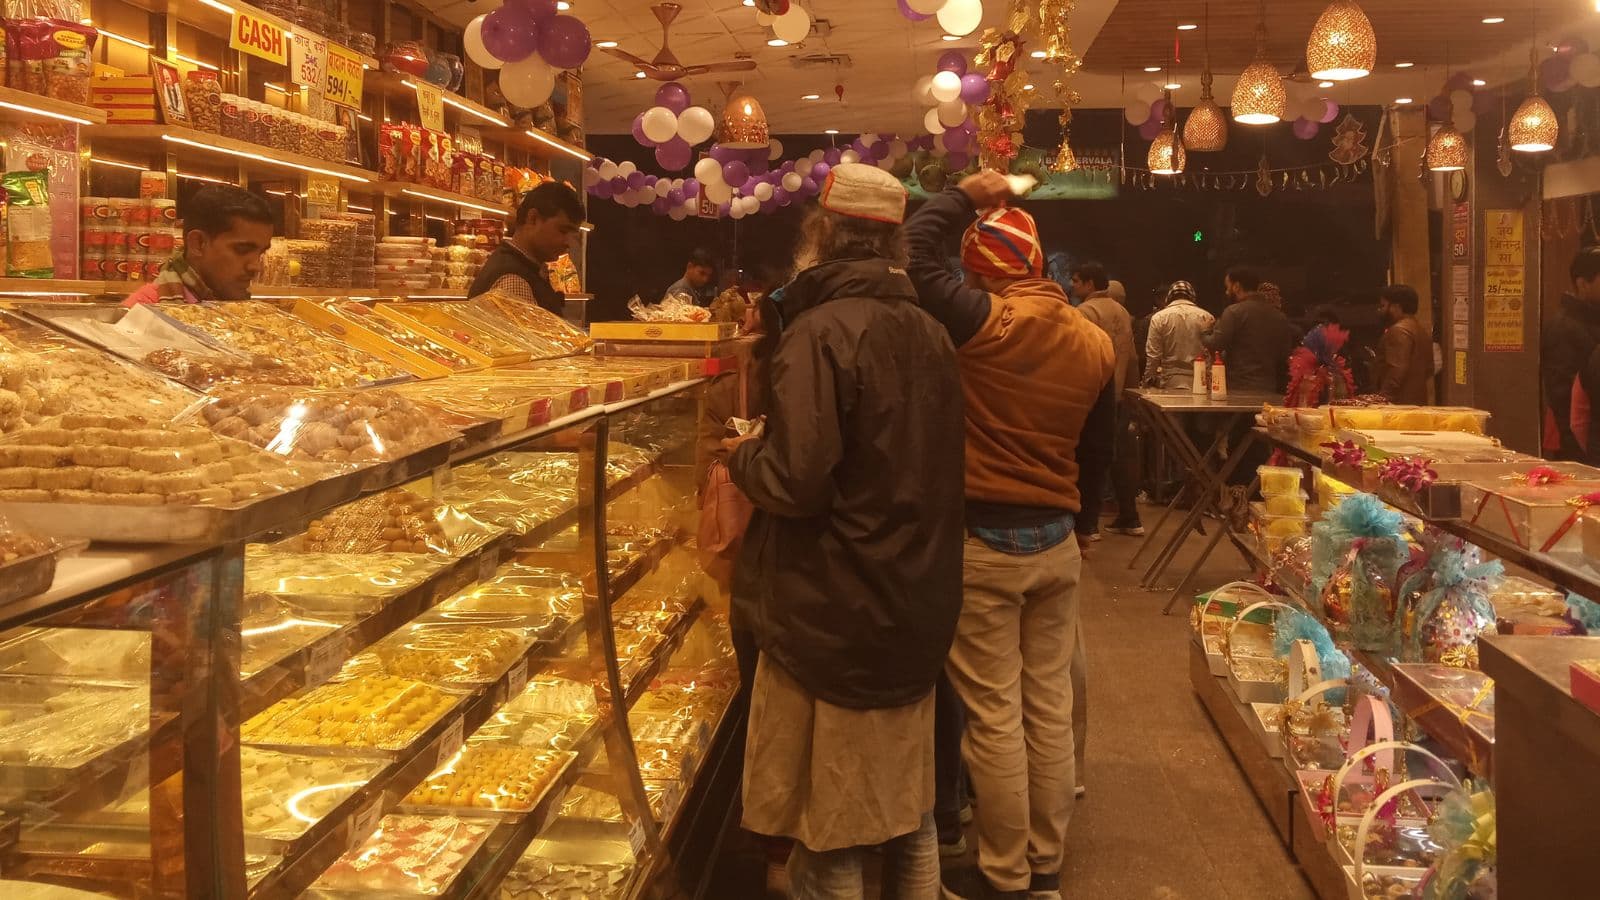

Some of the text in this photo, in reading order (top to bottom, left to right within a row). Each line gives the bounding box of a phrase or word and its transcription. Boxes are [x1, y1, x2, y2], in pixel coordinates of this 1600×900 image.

[238, 14, 283, 57] CASH
[327, 75, 352, 102] 594/-
[1045, 156, 1113, 165] BERVALA
